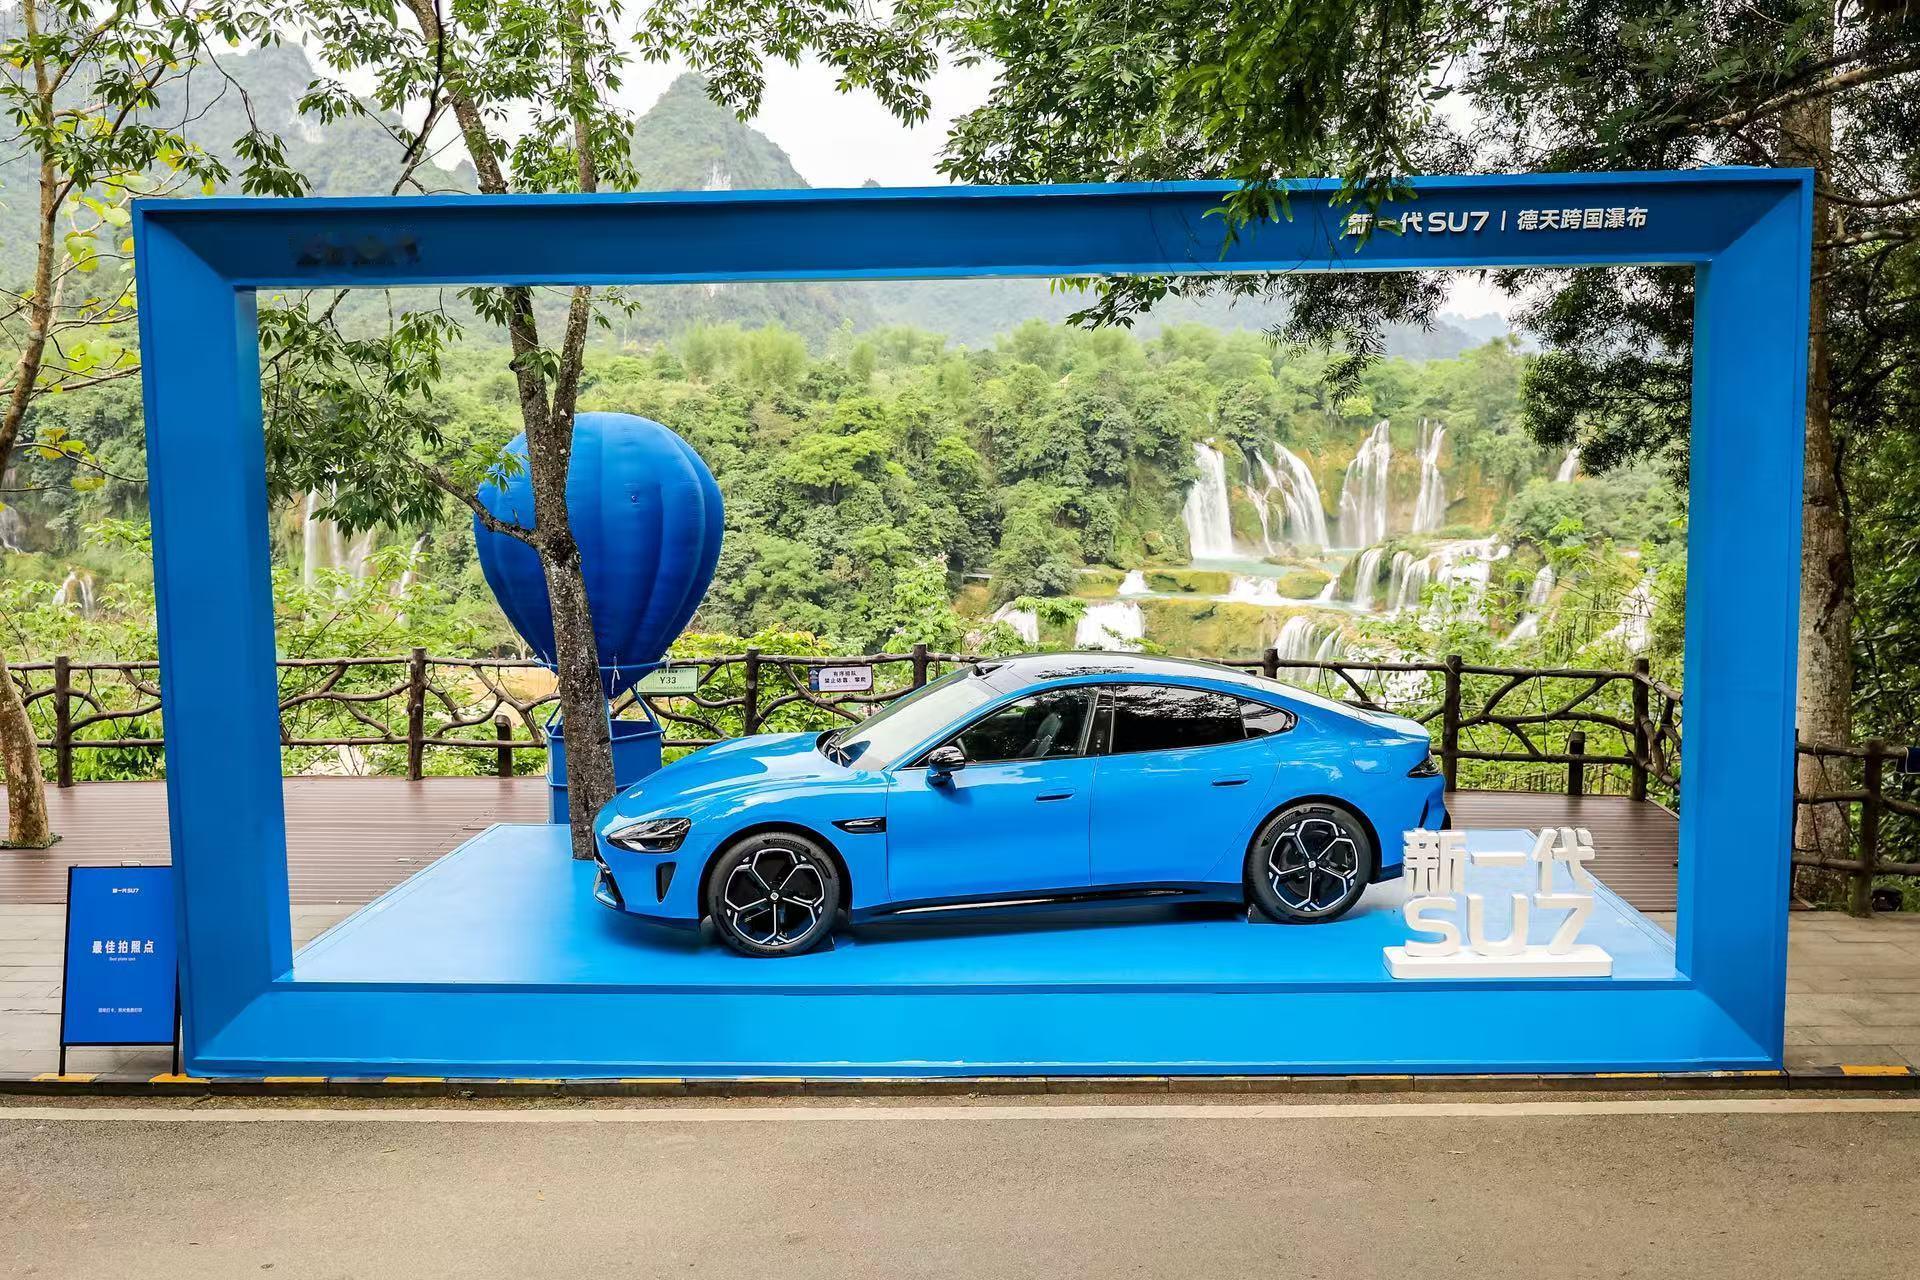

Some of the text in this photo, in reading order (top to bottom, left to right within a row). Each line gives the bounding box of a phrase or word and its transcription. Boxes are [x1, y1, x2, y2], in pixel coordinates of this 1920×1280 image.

[1517, 207, 1649, 231] 德天跨国瀑布
[660, 676, 677, 684] Y33
[1403, 827, 1595, 897] 新一代
[1404, 893, 1594, 957] SU7
[92, 940, 154, 954] 最佳拍照点
